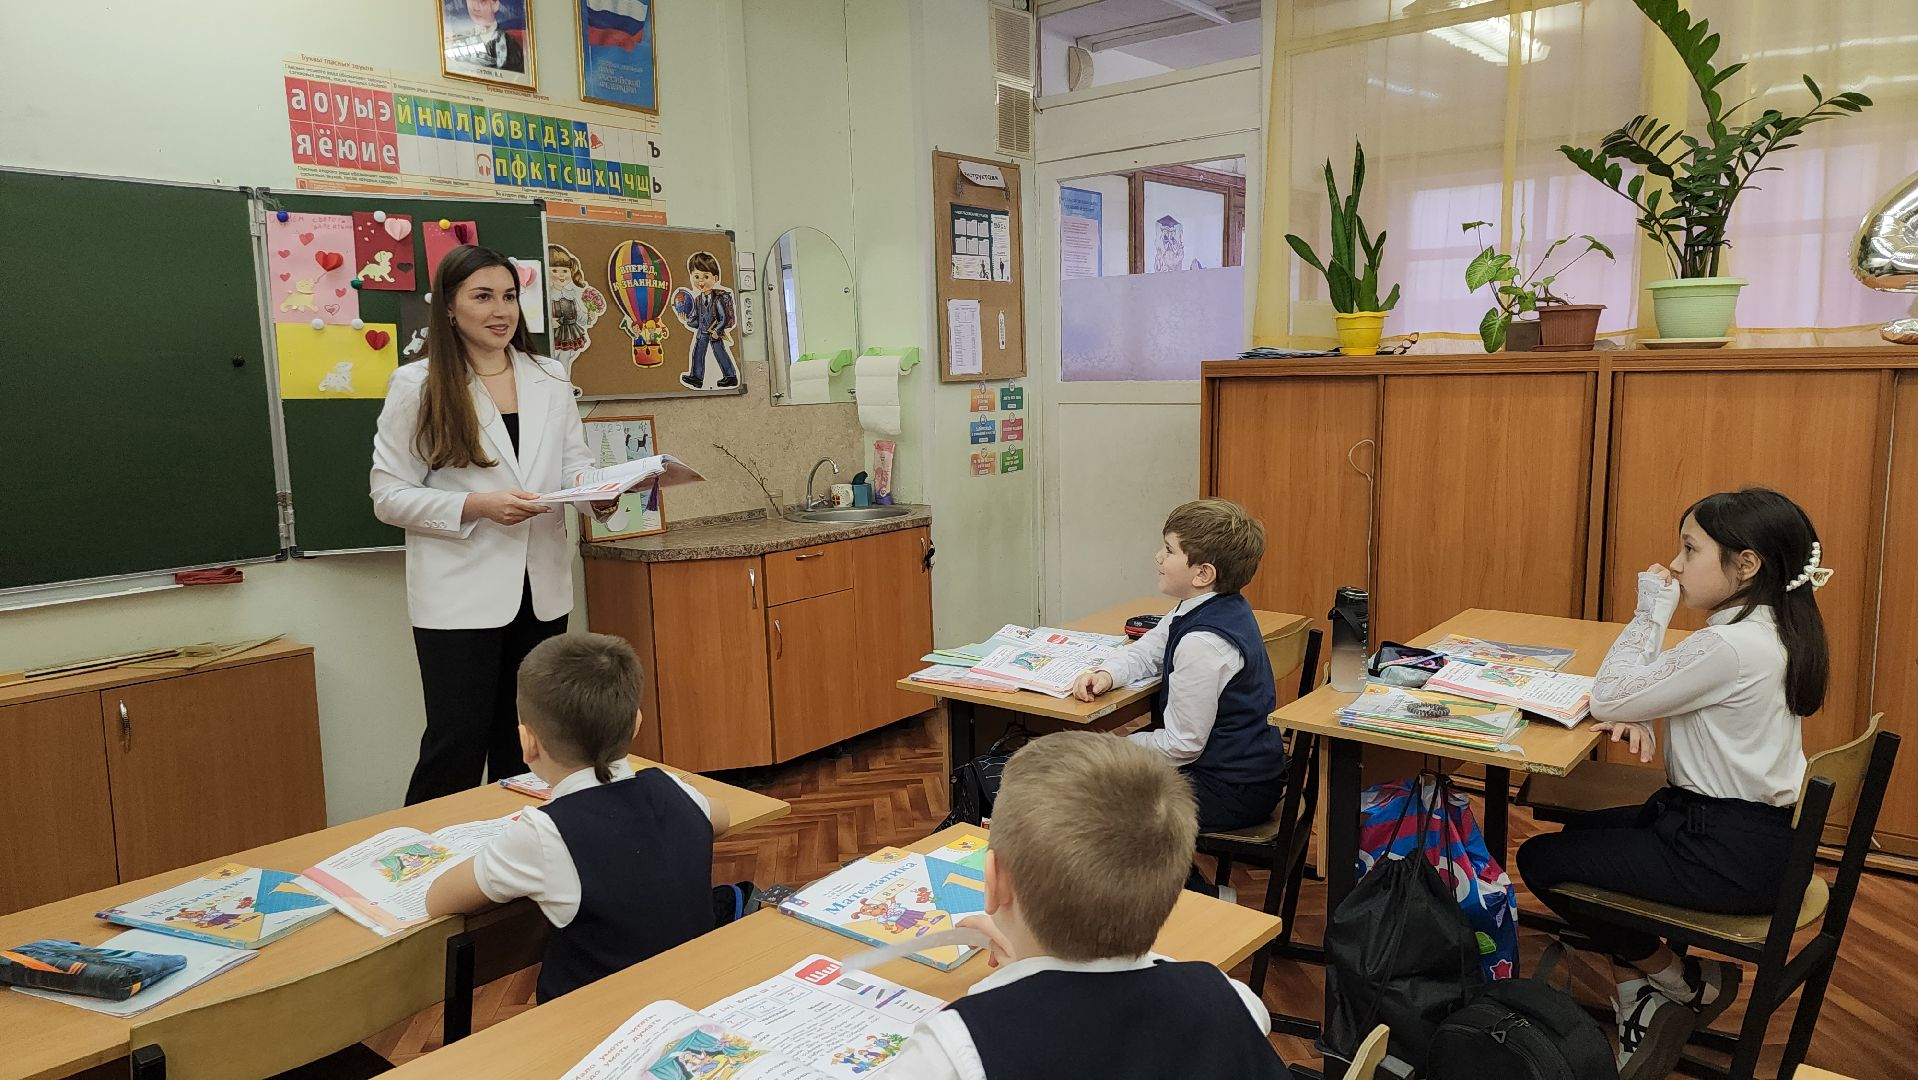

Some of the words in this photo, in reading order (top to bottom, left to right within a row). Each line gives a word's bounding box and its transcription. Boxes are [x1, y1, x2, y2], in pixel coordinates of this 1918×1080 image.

[620, 263, 658, 276] ВПЕРЁД,
[613, 282, 621, 292] К
[621, 278, 669, 291] ЗНАНИЯМ!
[824, 862, 918, 915] Математика
[804, 963, 842, 983] Шш
